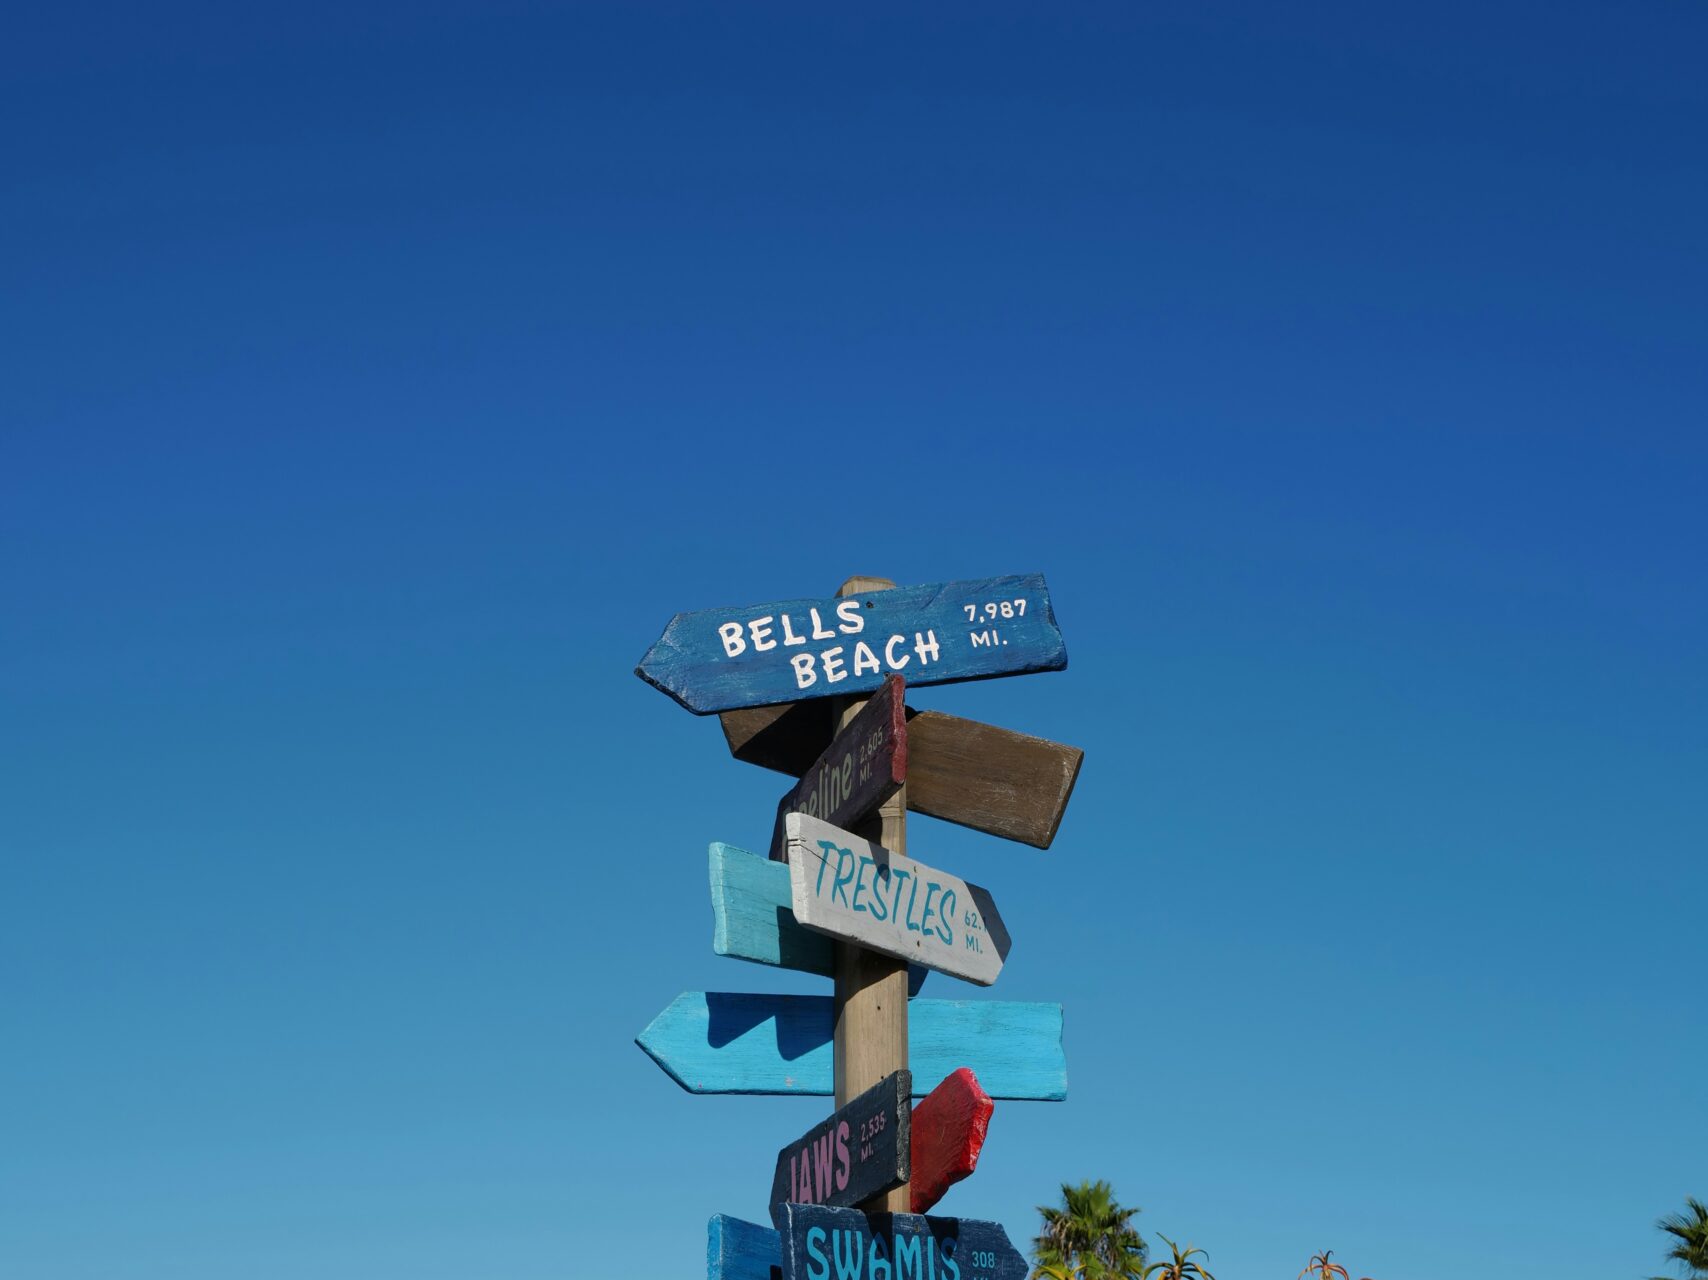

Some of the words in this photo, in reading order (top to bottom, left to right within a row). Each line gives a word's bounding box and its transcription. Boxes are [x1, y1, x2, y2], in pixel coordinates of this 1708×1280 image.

[963, 599, 1027, 624] 7,987
[718, 601, 865, 657] BELLS
[970, 630, 1009, 649] MI.
[789, 629, 940, 689] BEACH
[816, 839, 956, 946] TRESTLES
[965, 934, 983, 955] MI.
[971, 1250, 995, 1269] 308
